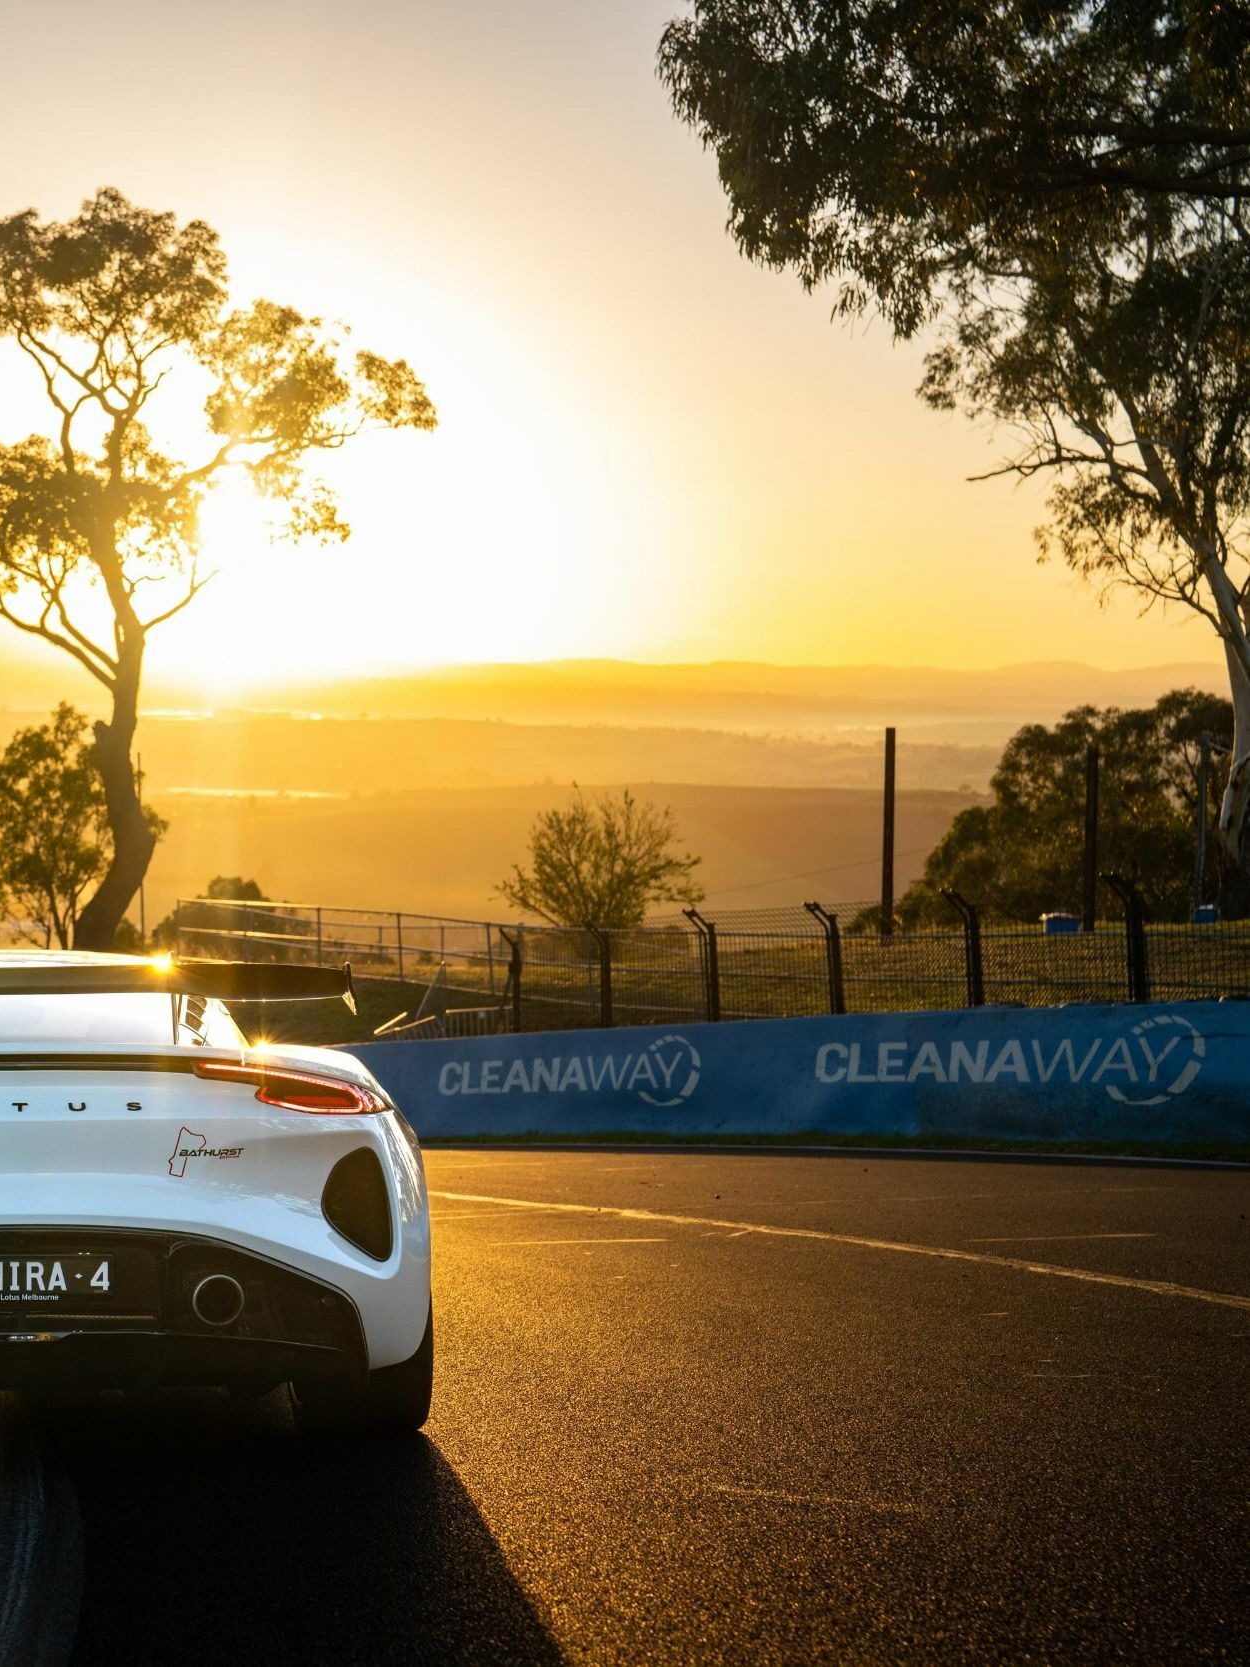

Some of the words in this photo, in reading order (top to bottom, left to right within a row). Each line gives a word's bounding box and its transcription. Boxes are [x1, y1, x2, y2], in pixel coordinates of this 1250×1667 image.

[438, 1051, 682, 1097] CLEANAWAY
[814, 1036, 1182, 1084] CLEANAWAY
[179, 1148, 245, 1156] BATHURST
[90, 1261, 110, 1291] 4
[0, 1293, 20, 1301] Lotus
[21, 1293, 59, 1301] Melbourne
